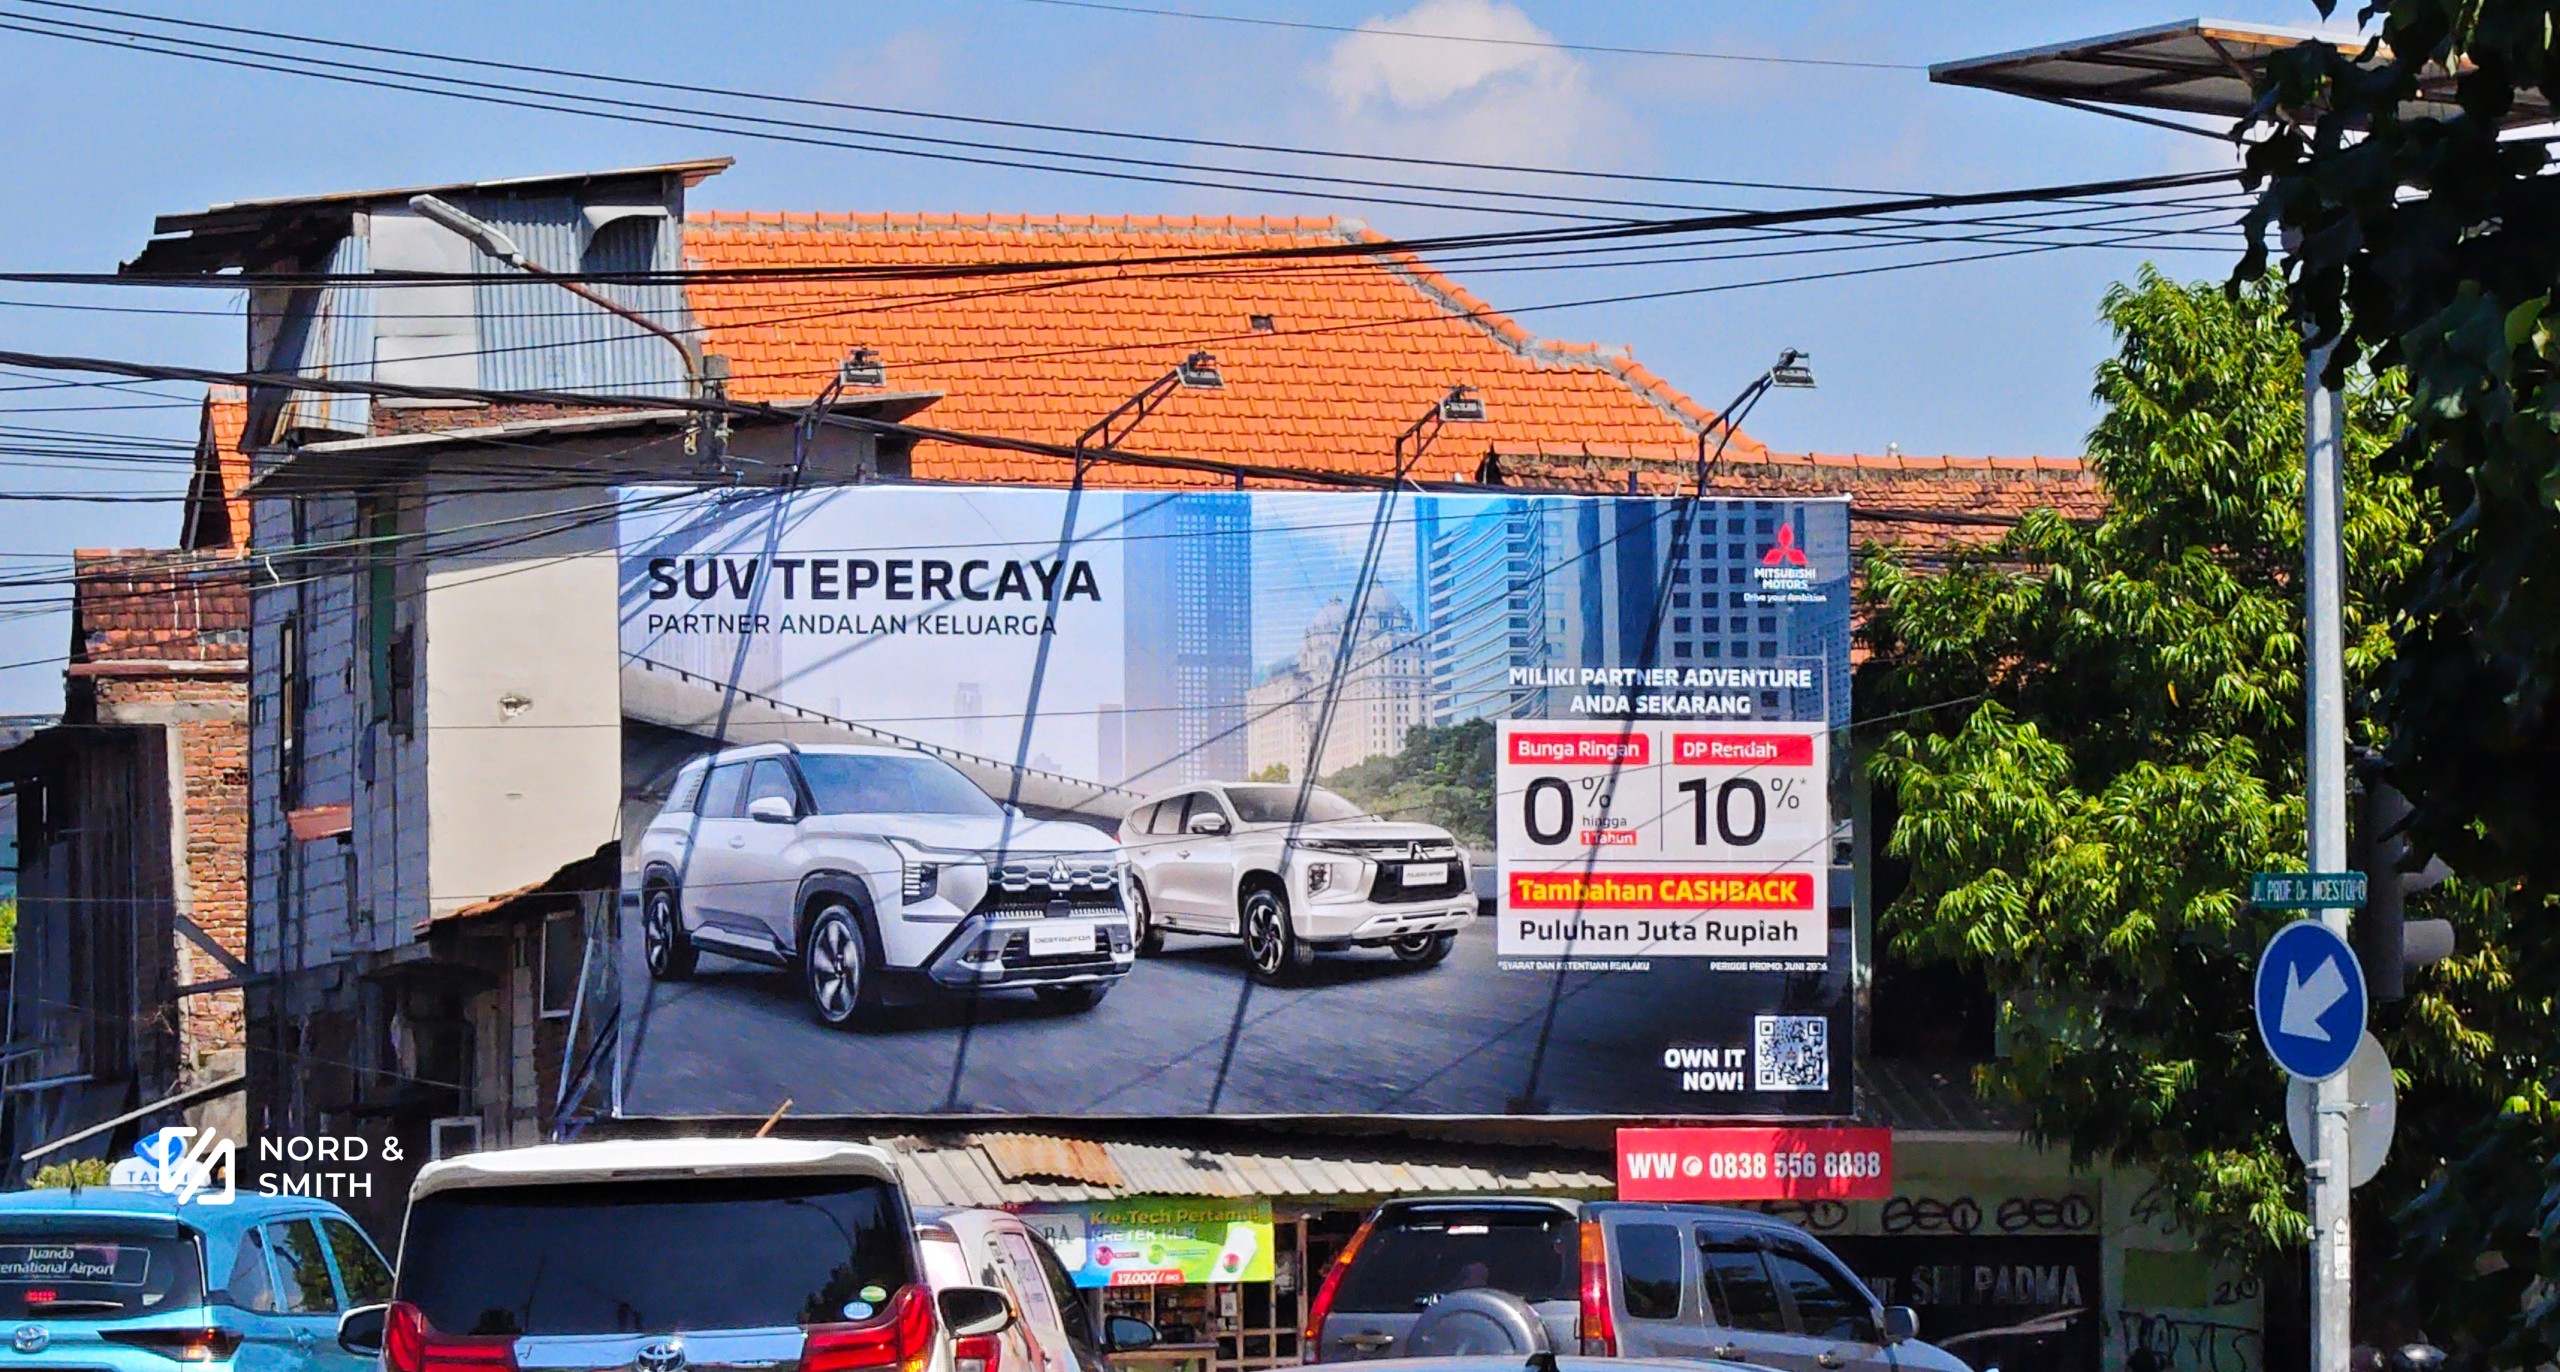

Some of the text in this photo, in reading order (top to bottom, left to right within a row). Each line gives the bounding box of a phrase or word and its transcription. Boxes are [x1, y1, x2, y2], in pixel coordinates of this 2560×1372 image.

[647, 559, 1102, 602] SUV TEPERCAYA
[1754, 567, 1816, 579] MITSUBISHI
[1762, 579, 1808, 589] MOTORS
[1743, 592, 1766, 602] Drive
[1767, 594, 1786, 603] your
[649, 614, 1056, 635] PARTNER ANDALAN KELUARGA
[1509, 668, 1811, 688] MILIKI PARTNER ADVENTURE
[1570, 696, 1751, 714] ANDA SEKARANG
[1518, 741, 1640, 759] Bunga Ringan
[1683, 743, 1777, 759] DP Rendah
[1582, 815, 1627, 829] hingga
[1583, 832, 1633, 844] 1 Tahun
[1518, 880, 1798, 902] Tambahan CASHBACK
[2313, 879, 2366, 901] MOESTOPO
[1520, 919, 1798, 946] Puluhan Juta Rupiah
[1536, 961, 1555, 971] DAN
[1556, 961, 1608, 971] KETENTUAN
[1610, 961, 1650, 971] BERLAKU
[1710, 961, 1748, 971] PERIODE
[1784, 962, 1804, 971] JUNI
[1665, 1049, 1746, 1069] OWN IT
[1683, 1072, 1744, 1091] NOW!
[1627, 1151, 1880, 1179] WW 0838 556 8888
[1090, 1209, 1171, 1225] Kre-Tech
[29, 1248, 74, 1261] Juanda
[0, 1261, 114, 1277] ernational Airport
[1911, 1265, 1961, 1306] SRI
[1974, 1265, 2083, 1306] PADMA
